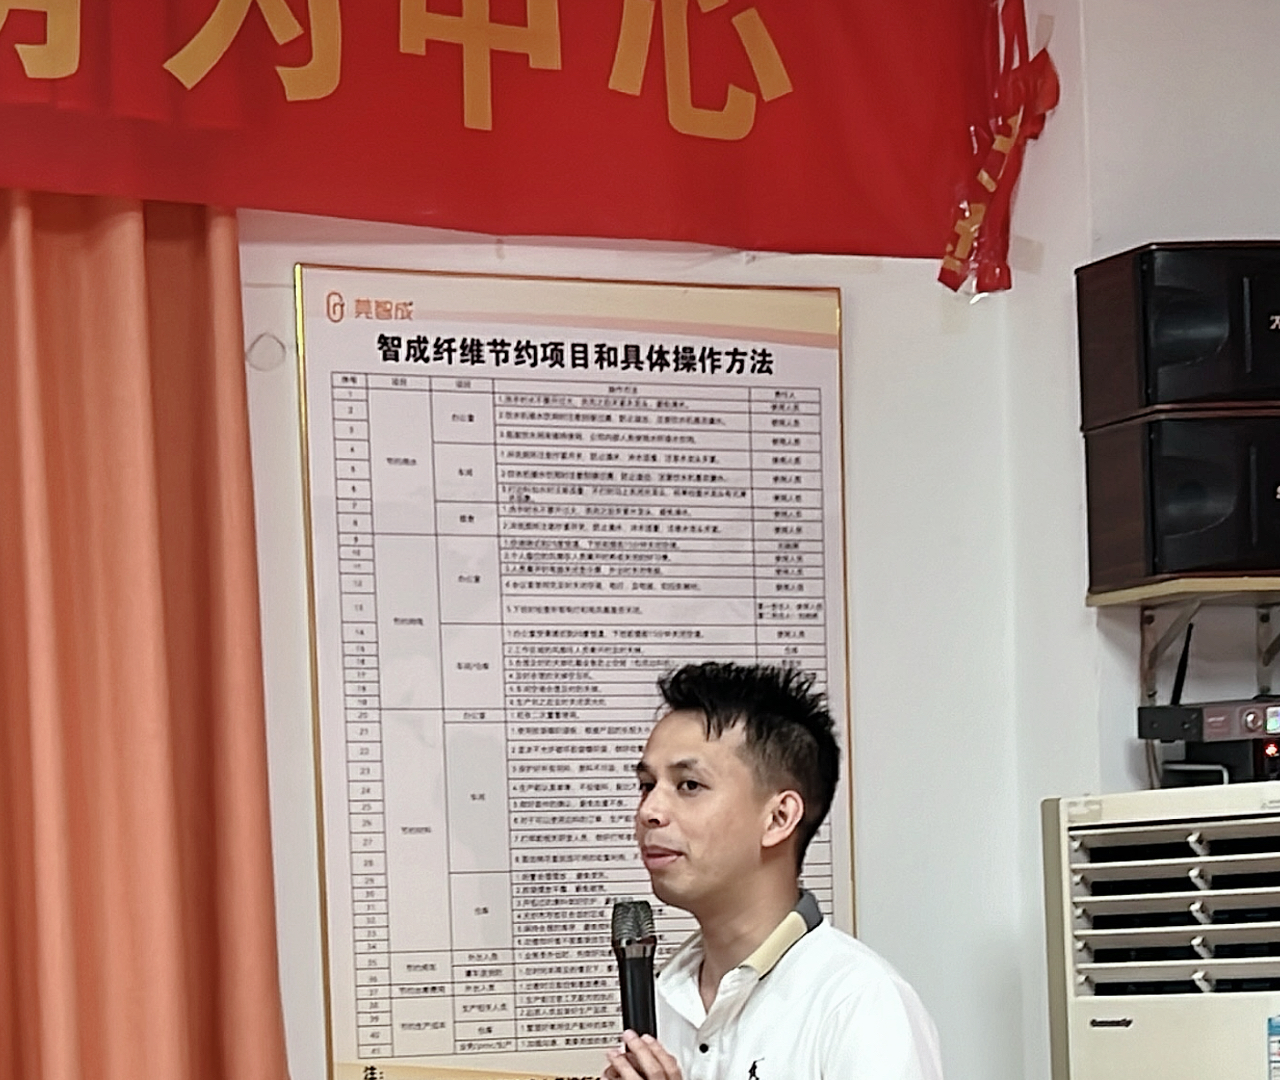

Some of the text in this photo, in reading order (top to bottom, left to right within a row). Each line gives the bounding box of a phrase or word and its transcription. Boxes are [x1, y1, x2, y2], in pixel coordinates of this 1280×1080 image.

[377, 333, 773, 375] 智成纤维节约项目和具体操作方法
